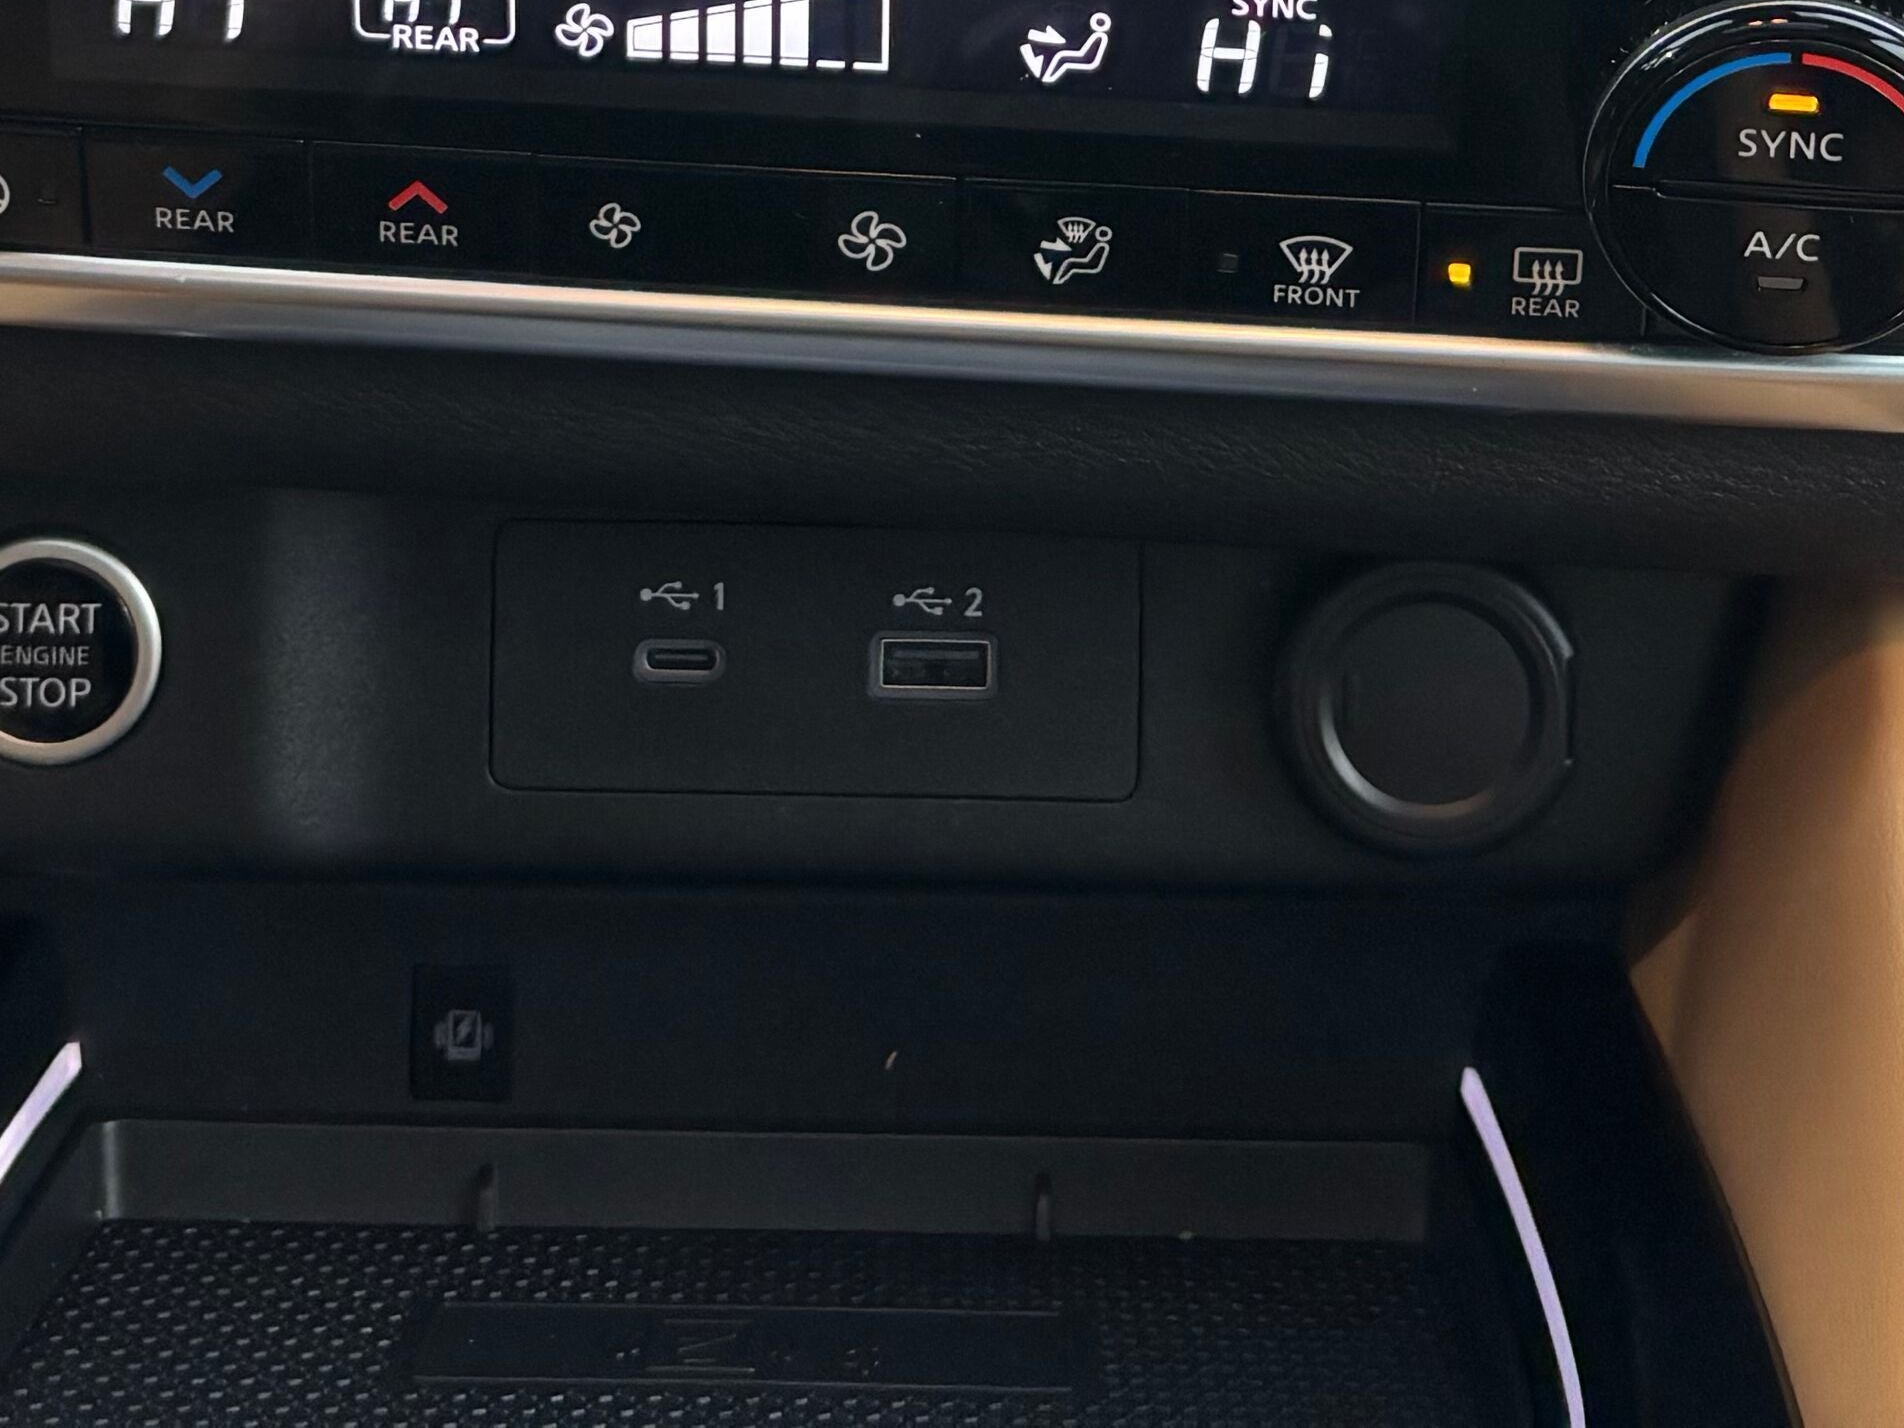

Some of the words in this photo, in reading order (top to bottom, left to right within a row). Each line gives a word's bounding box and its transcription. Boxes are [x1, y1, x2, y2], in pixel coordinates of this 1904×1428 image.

[391, 23, 481, 53] REAR
[1736, 127, 1845, 164] SYNC
[154, 205, 236, 235] REAR
[378, 219, 460, 248] REAR
[1742, 230, 1822, 264] A/C
[1272, 283, 1361, 309] FRONT
[1510, 294, 1582, 320] REAR
[713, 581, 726, 612] 1
[963, 586, 985, 619] 2
[0, 644, 91, 666] ENGINE
